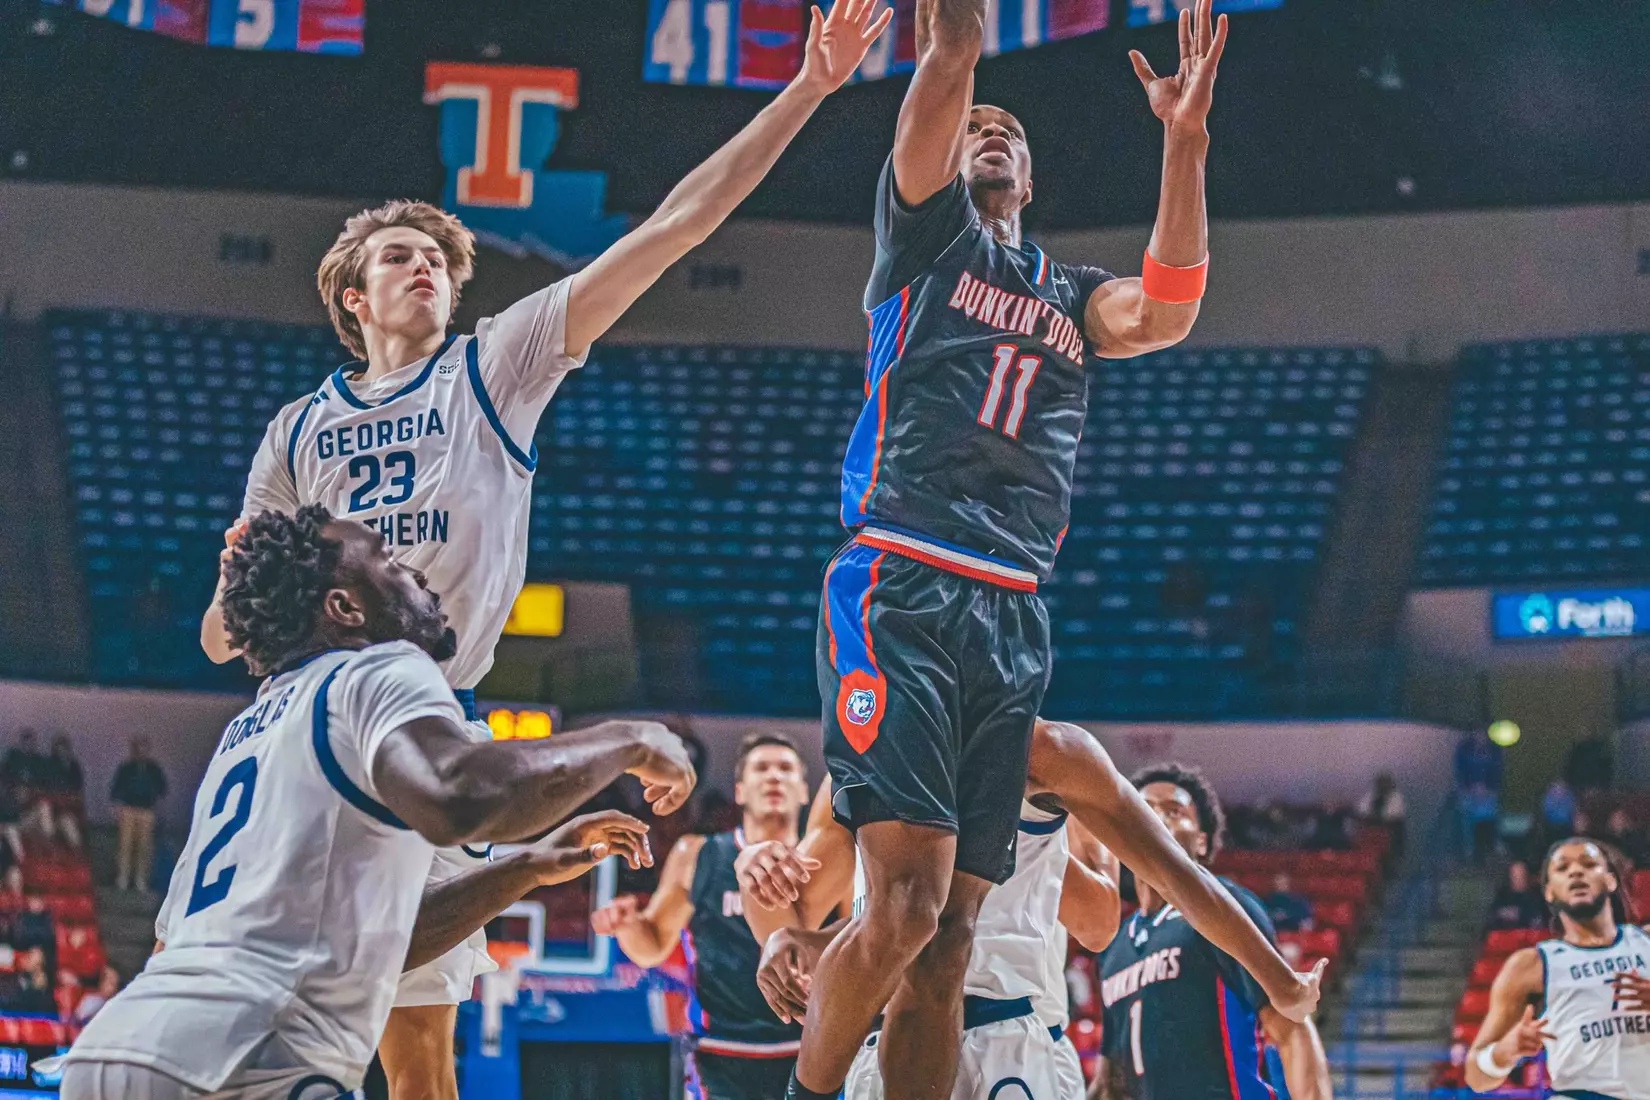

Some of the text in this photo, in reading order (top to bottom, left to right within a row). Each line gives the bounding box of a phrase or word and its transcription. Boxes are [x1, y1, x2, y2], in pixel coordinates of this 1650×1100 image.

[977, 343, 1042, 439] 11
[317, 408, 444, 459] GEORGIA
[348, 450, 416, 513] 23
[184, 755, 258, 918] 2
[1569, 954, 1646, 981] GEORGIA
[1129, 999, 1145, 1076] 1
